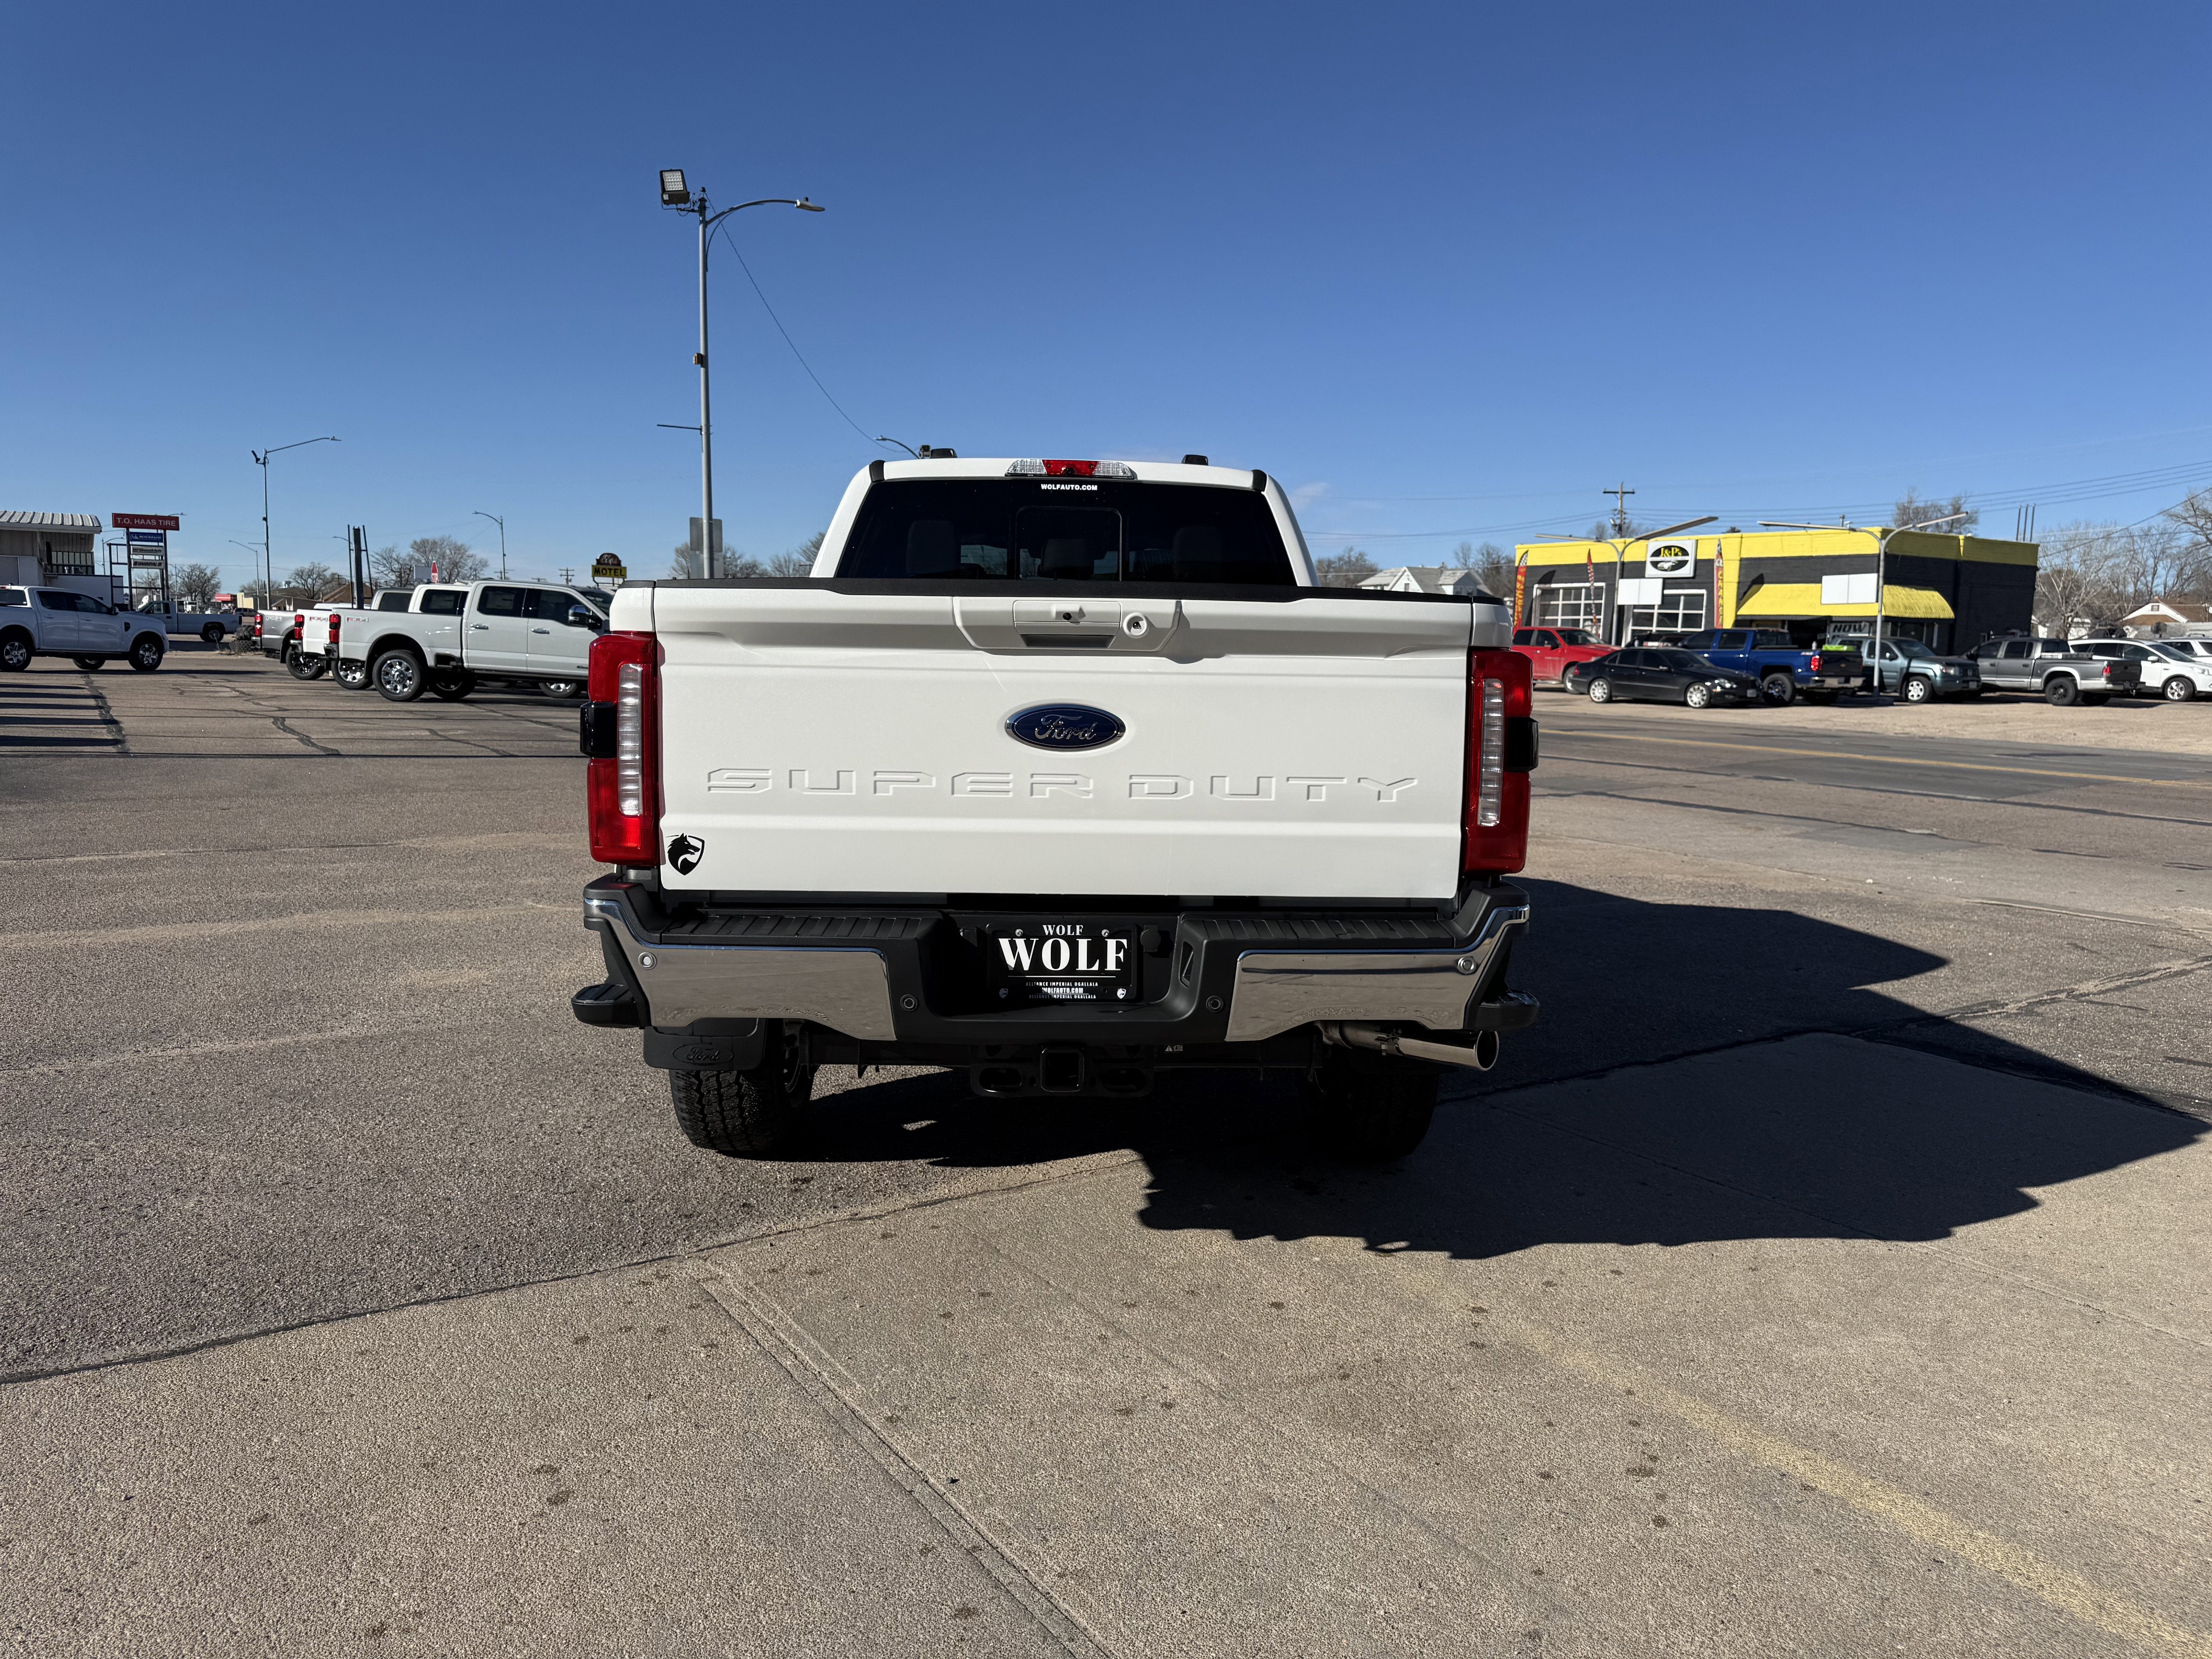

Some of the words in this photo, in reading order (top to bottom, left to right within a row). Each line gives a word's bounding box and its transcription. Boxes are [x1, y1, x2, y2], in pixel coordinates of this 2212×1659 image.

[594, 567, 624, 576] MOTEL
[1832, 623, 1866, 632] NOW
[1035, 714, 1098, 739] Ford
[707, 768, 1093, 799] SUPER
[1128, 775, 1419, 803] DUTY
[1042, 925, 1083, 936] WOLF
[998, 938, 1127, 971] WOLF
[687, 1047, 720, 1060] Ford
